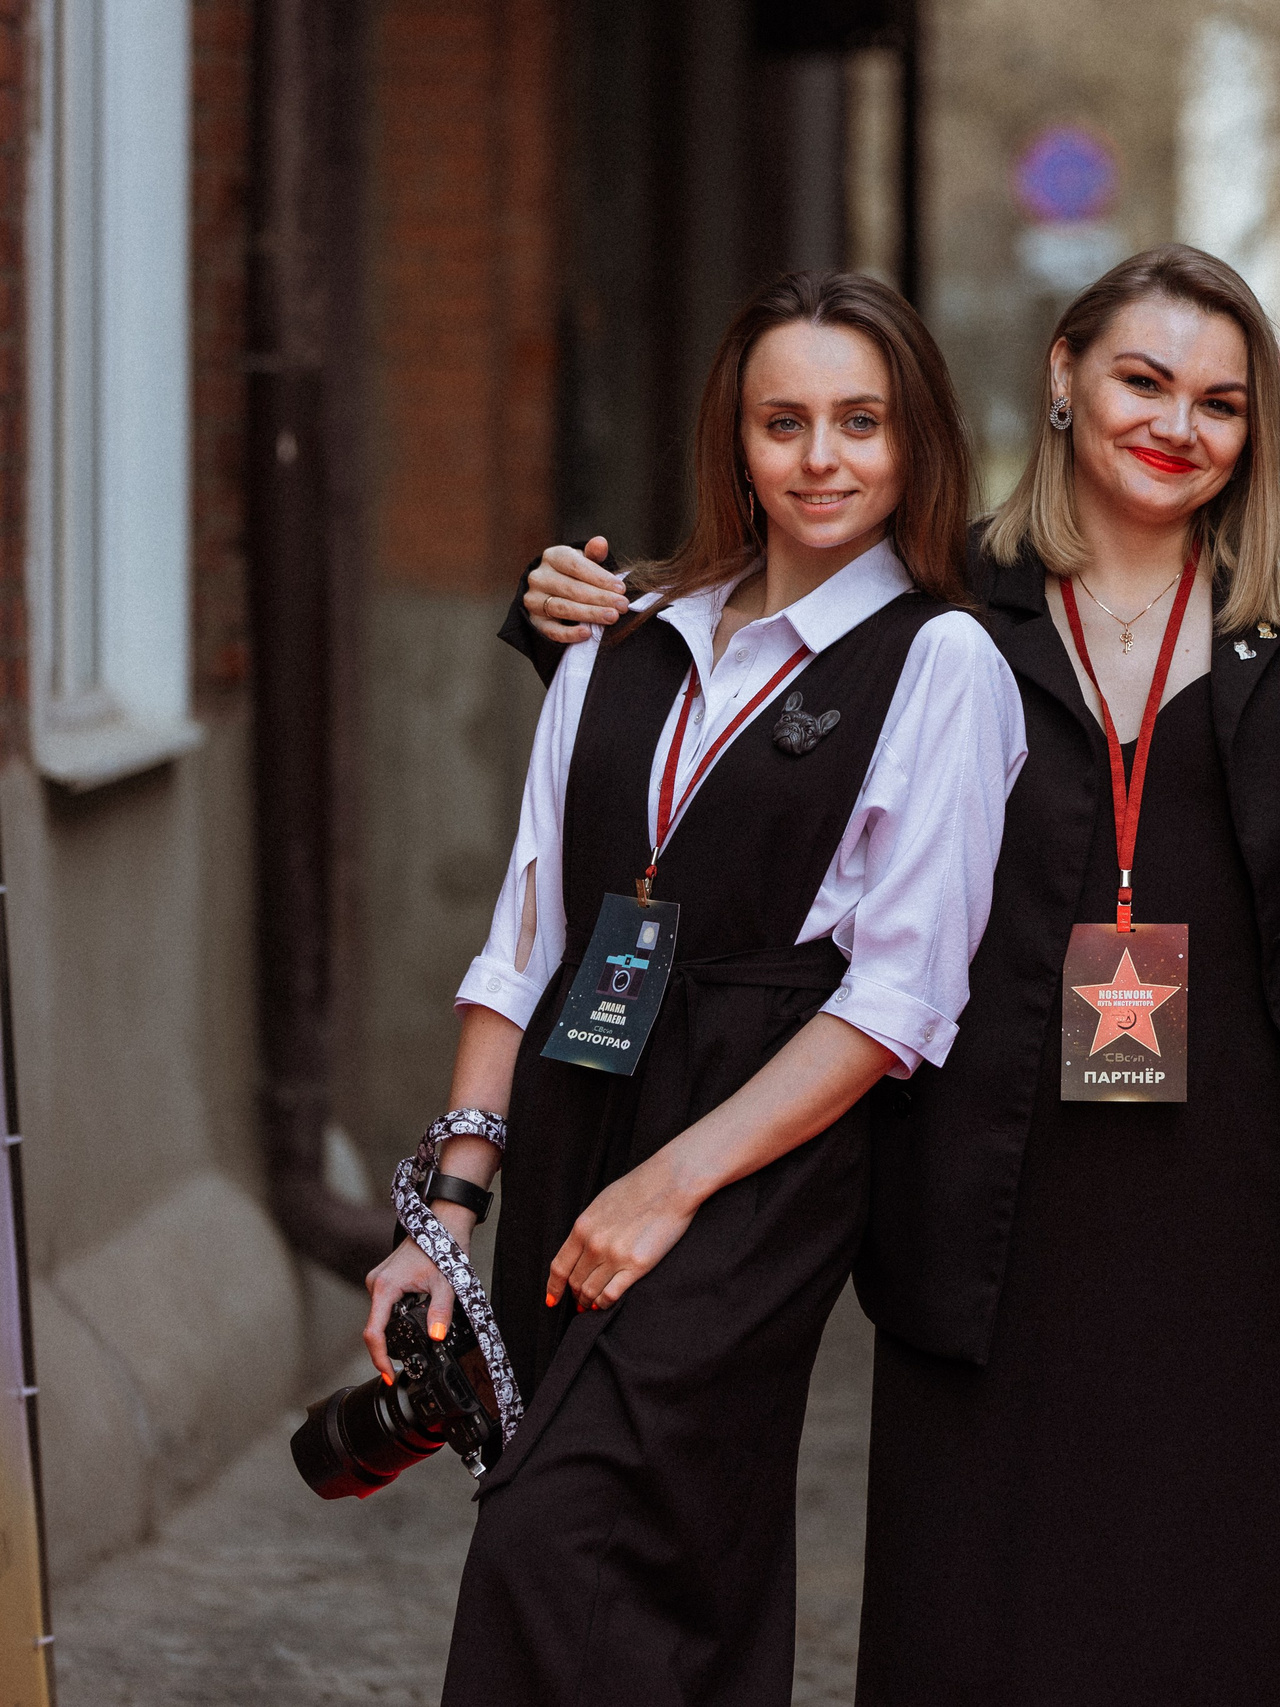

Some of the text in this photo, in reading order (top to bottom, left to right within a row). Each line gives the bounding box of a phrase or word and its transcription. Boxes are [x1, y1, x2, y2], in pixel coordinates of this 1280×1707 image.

[1098, 990, 1153, 1000] NOSEWORK
[598, 1001, 626, 1014] ДИАНА
[589, 1010, 627, 1026] КАМАЕВА
[567, 1028, 631, 1051] ФОТОГРАФ
[1084, 1067, 1166, 1084] ПАРТНЁР
